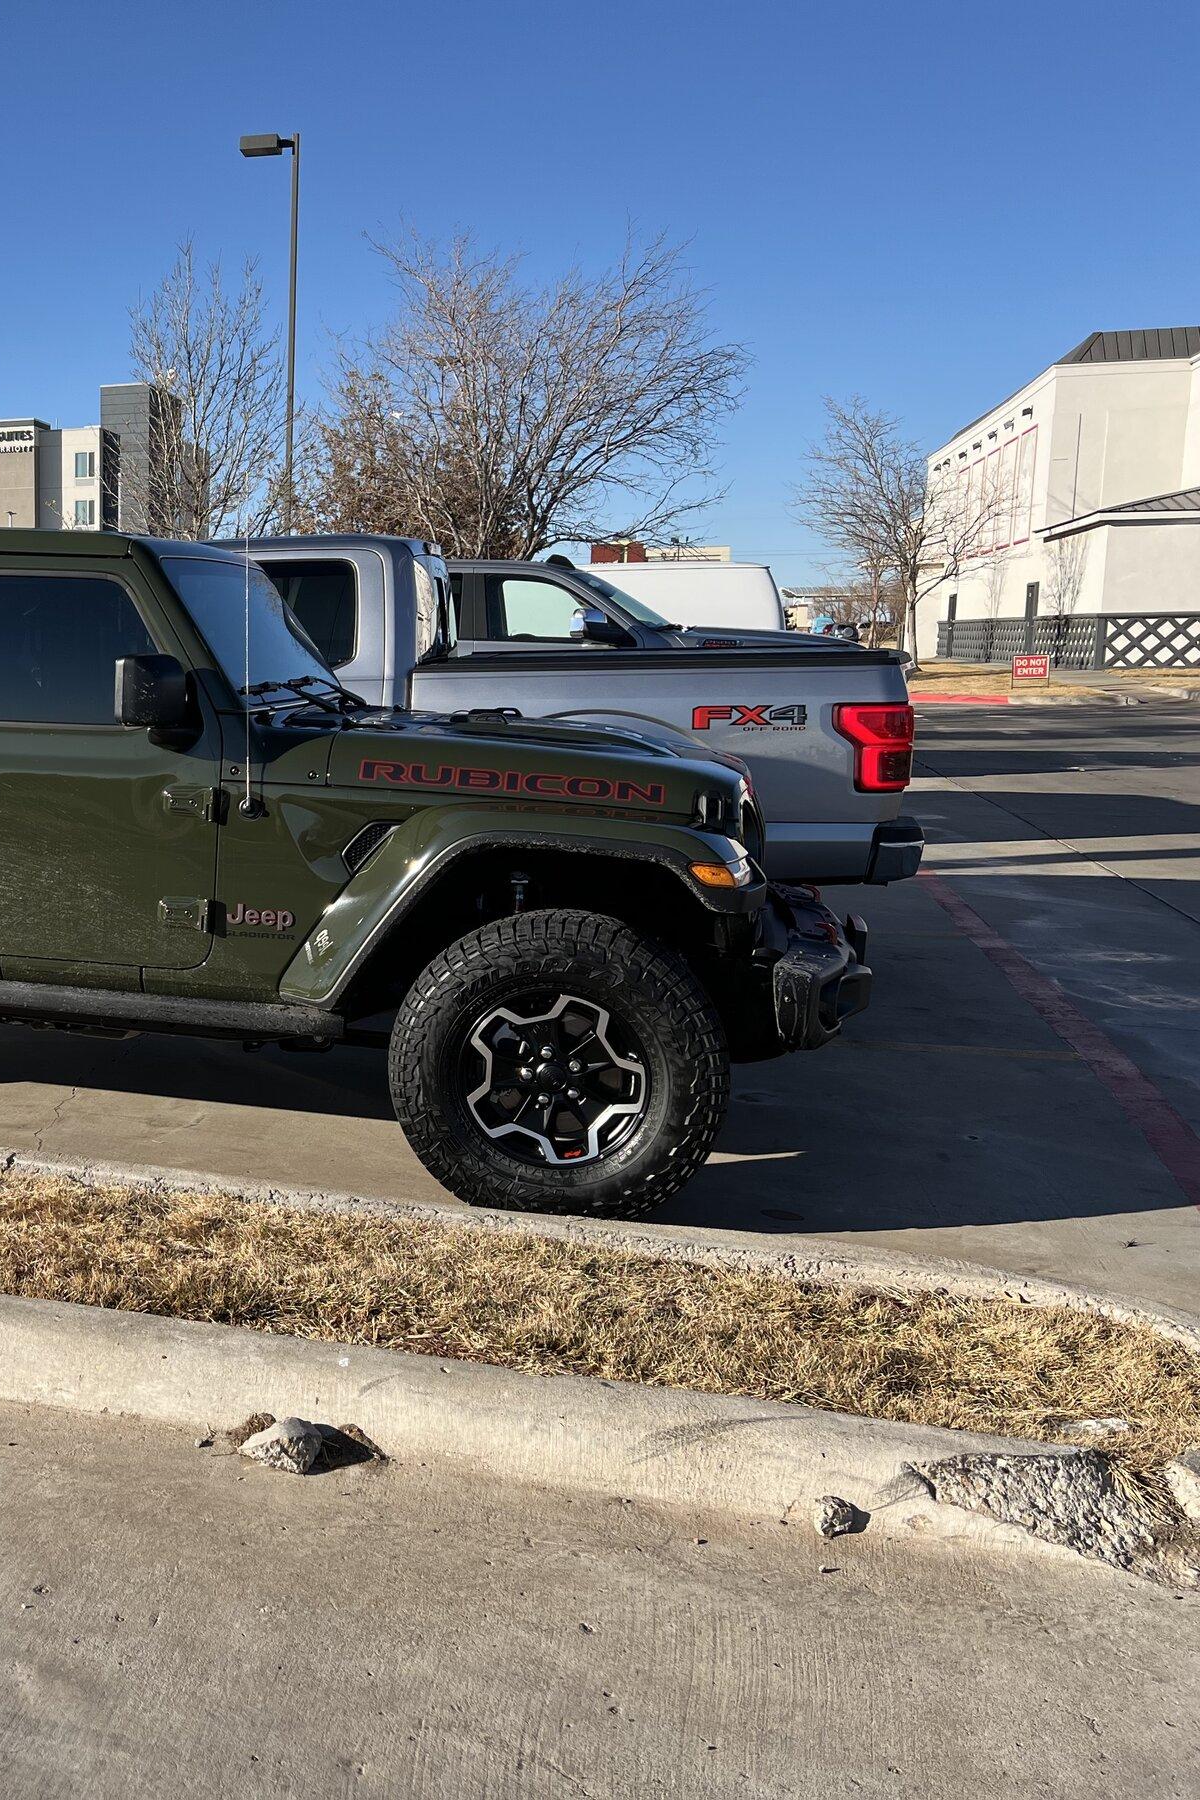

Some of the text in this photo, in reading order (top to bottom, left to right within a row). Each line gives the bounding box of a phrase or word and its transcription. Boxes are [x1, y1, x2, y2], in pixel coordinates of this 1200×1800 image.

[1016, 658, 1047, 666] DO NOT
[1017, 667, 1045, 675] ENTER
[692, 704, 808, 730] FX4
[358, 759, 666, 805] RUBICON
[226, 903, 295, 931] Jeep
[225, 930, 296, 941] GLADIATOR
